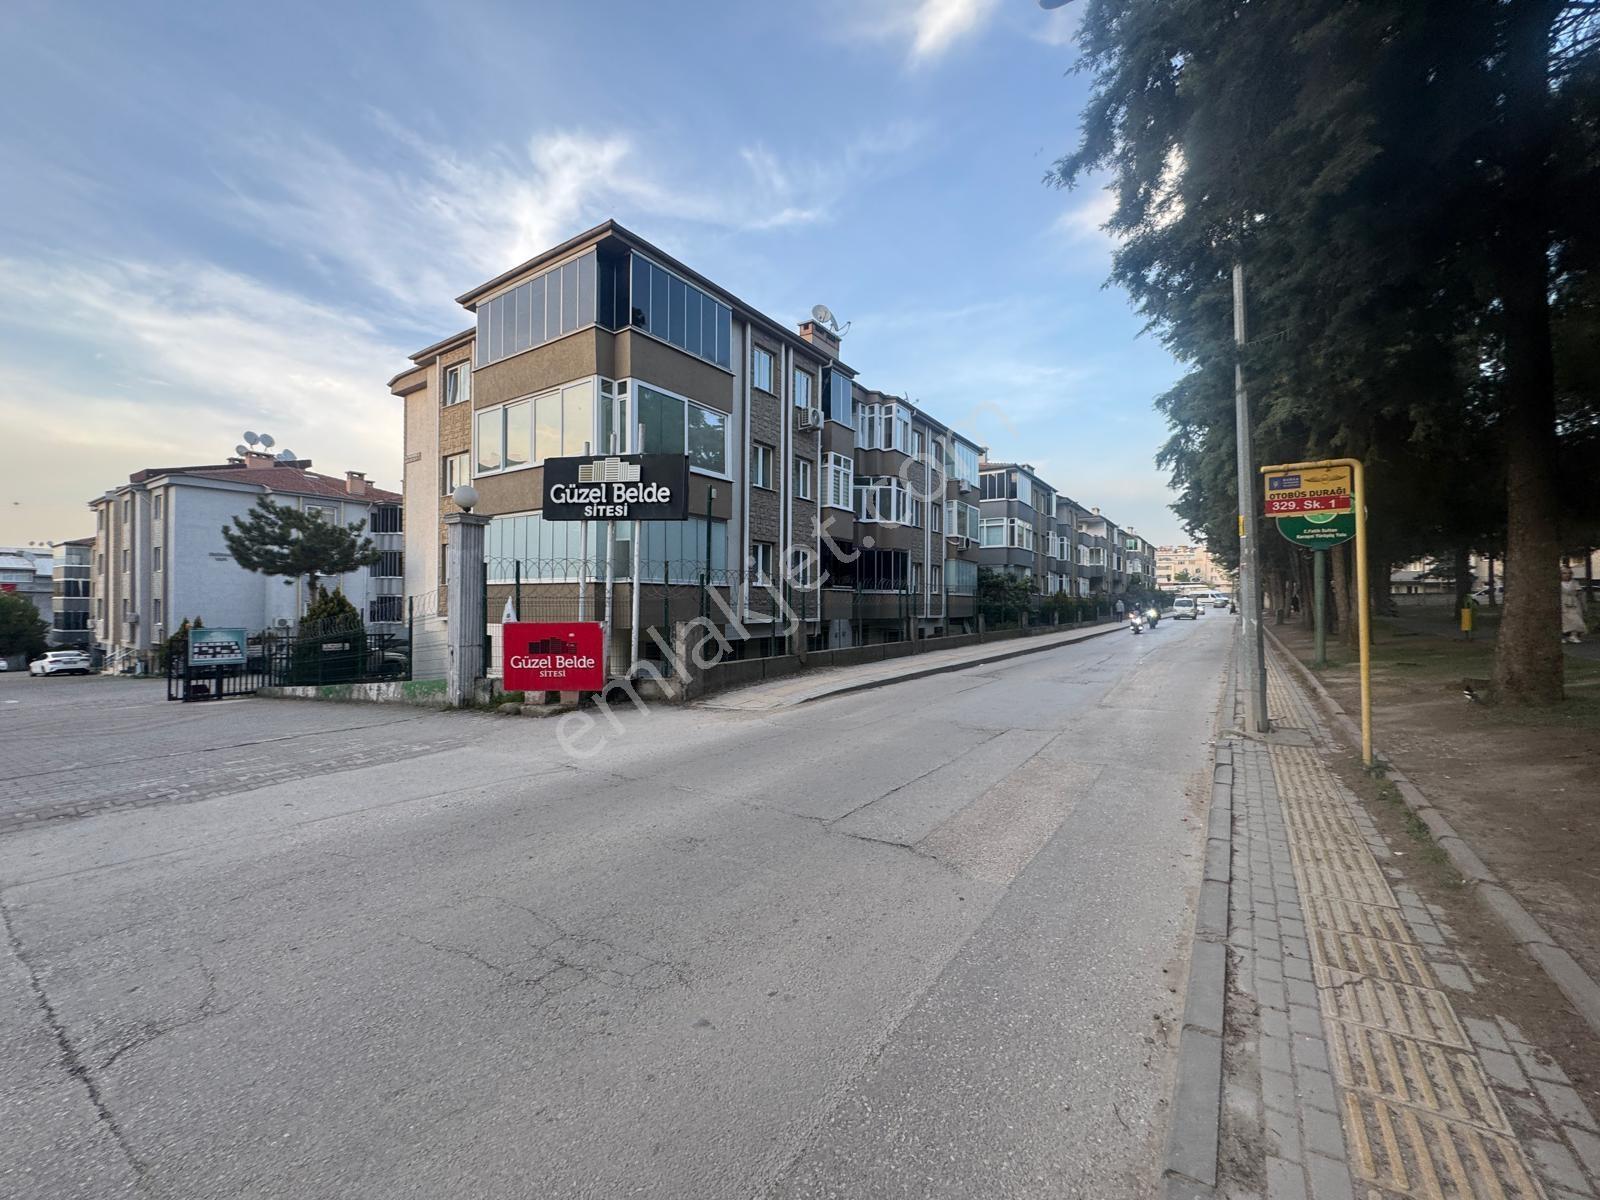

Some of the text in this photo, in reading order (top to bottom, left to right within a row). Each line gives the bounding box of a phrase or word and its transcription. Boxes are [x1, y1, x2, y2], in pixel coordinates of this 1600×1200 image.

[550, 482, 670, 503] Güzel Belde
[1269, 487, 1346, 500] OTOBÜS DURAĞI
[584, 503, 628, 517] SİTESİ
[1272, 499, 1336, 511] 329. Sk. 1
[510, 655, 595, 669] Güzel Belde
[539, 669, 566, 677] SİTESİ
